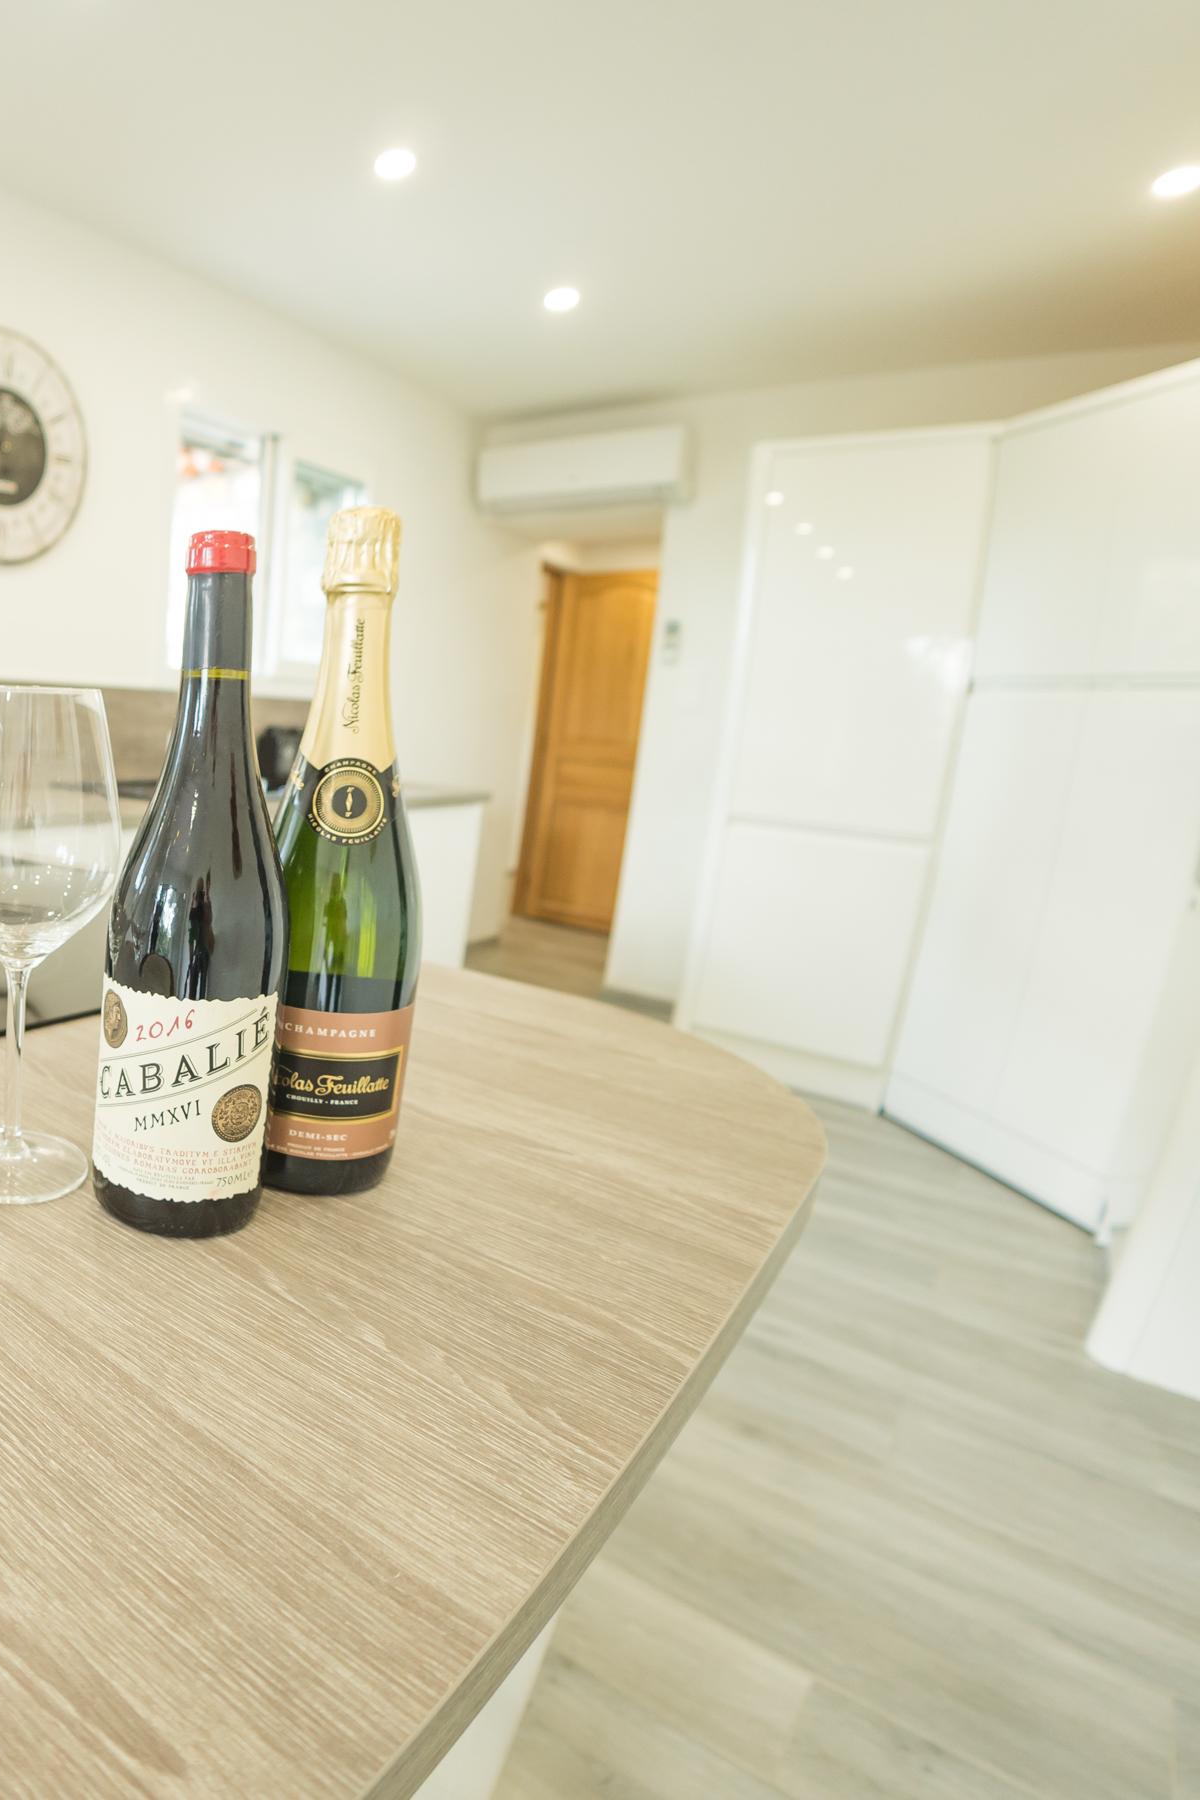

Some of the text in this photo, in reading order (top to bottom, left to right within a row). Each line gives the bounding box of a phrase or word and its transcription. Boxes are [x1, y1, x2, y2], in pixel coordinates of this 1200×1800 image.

[342, 617, 365, 734] Nicolas Feuillatte
[324, 760, 377, 775] CHAMPAGNE
[308, 813, 387, 845] NICOLAS FEUILLATTE
[136, 1008, 195, 1042] 2016
[284, 1022, 376, 1039] CHAMPAGNE
[100, 1006, 270, 1099] CABALIÉ
[314, 1074, 390, 1096] Feuillatte
[134, 1099, 201, 1132] MMXVI
[288, 1129, 348, 1141] DEMI-SEC
